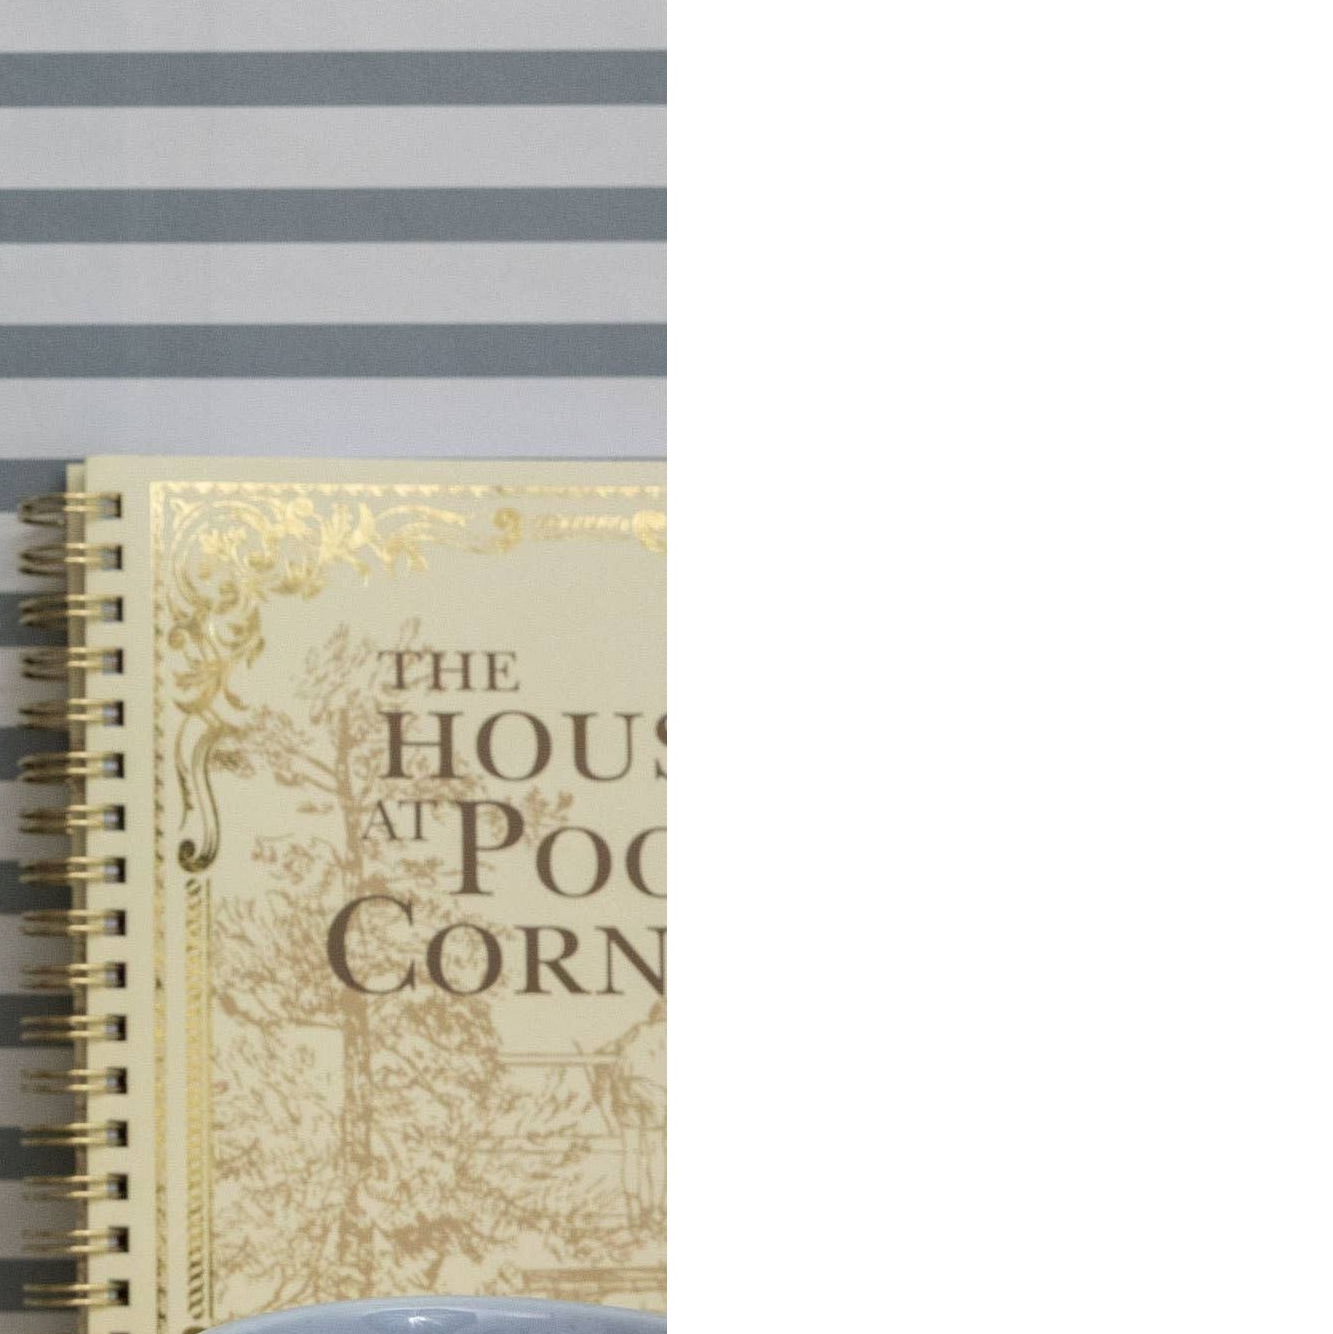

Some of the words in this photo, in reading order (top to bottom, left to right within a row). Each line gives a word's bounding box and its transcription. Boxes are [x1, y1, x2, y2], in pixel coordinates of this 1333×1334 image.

[377, 650, 521, 692] THE
[378, 710, 666, 781] HOU
[362, 799, 437, 841] AT
[326, 894, 666, 996] CORN
